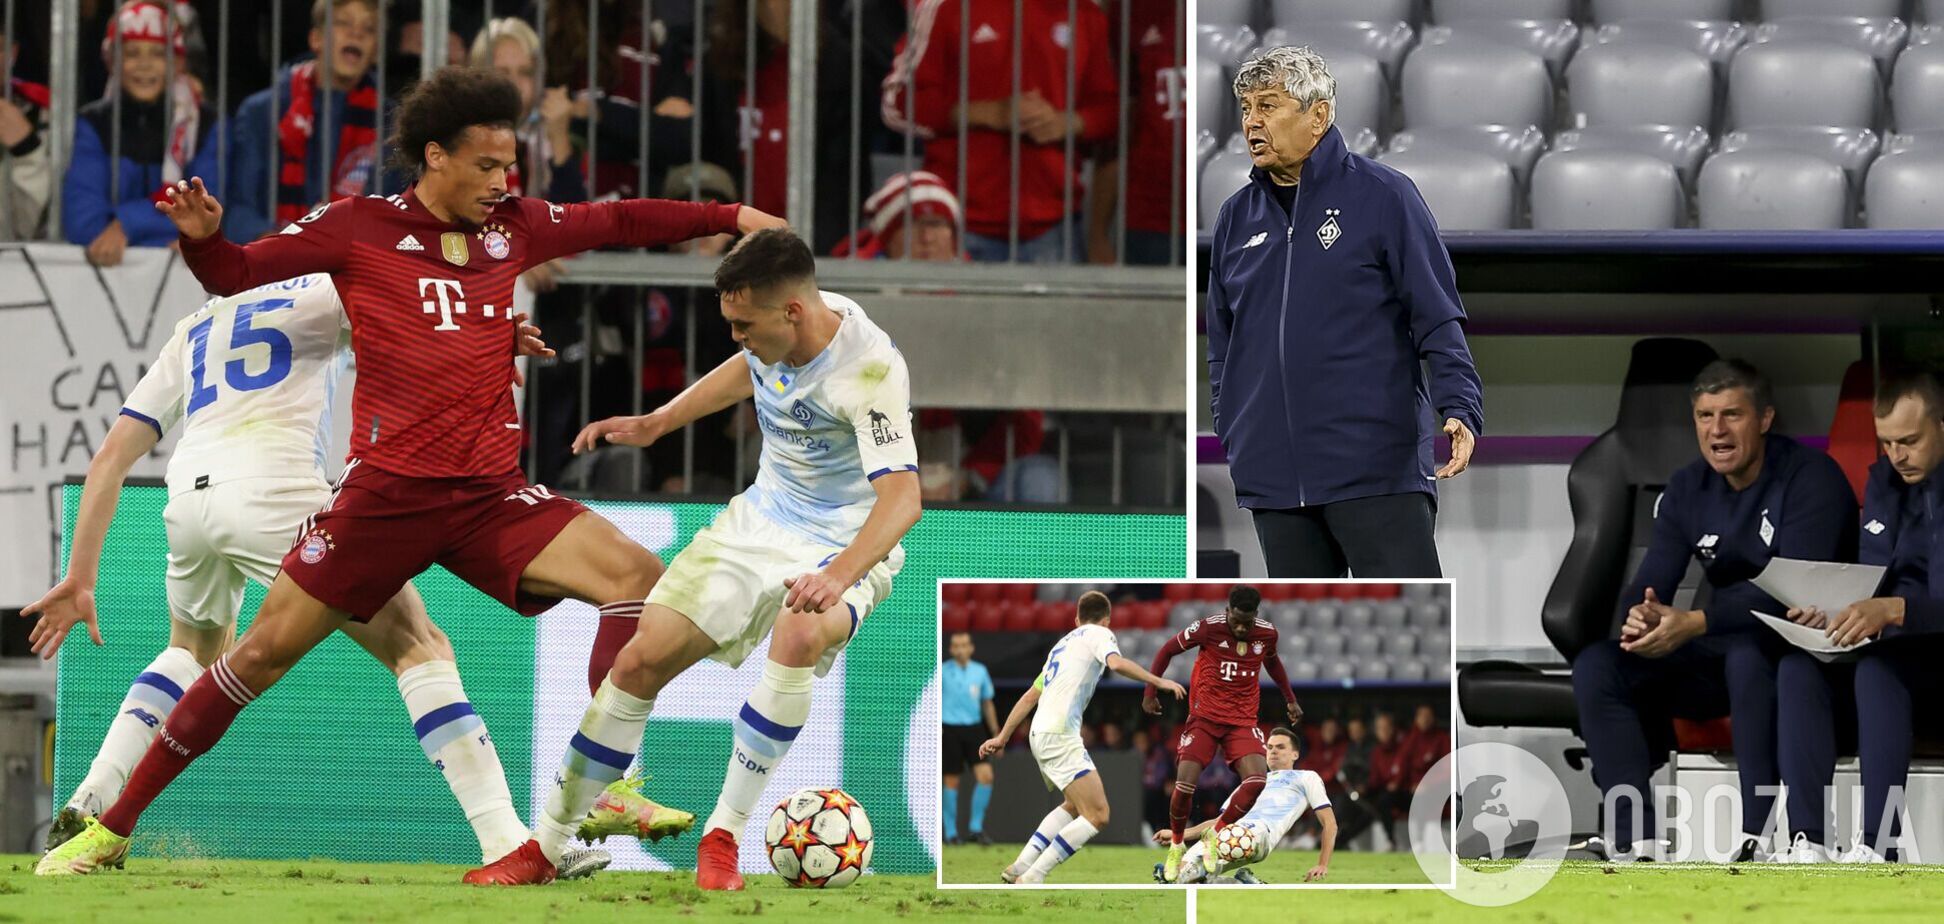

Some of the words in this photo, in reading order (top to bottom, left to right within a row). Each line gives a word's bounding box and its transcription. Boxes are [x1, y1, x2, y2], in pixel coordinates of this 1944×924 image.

[187, 299, 294, 417] 15
[51, 362, 149, 411] CA
[872, 427, 888, 438] PIT
[875, 432, 903, 446] BULL
[1044, 645, 1067, 686] 5
